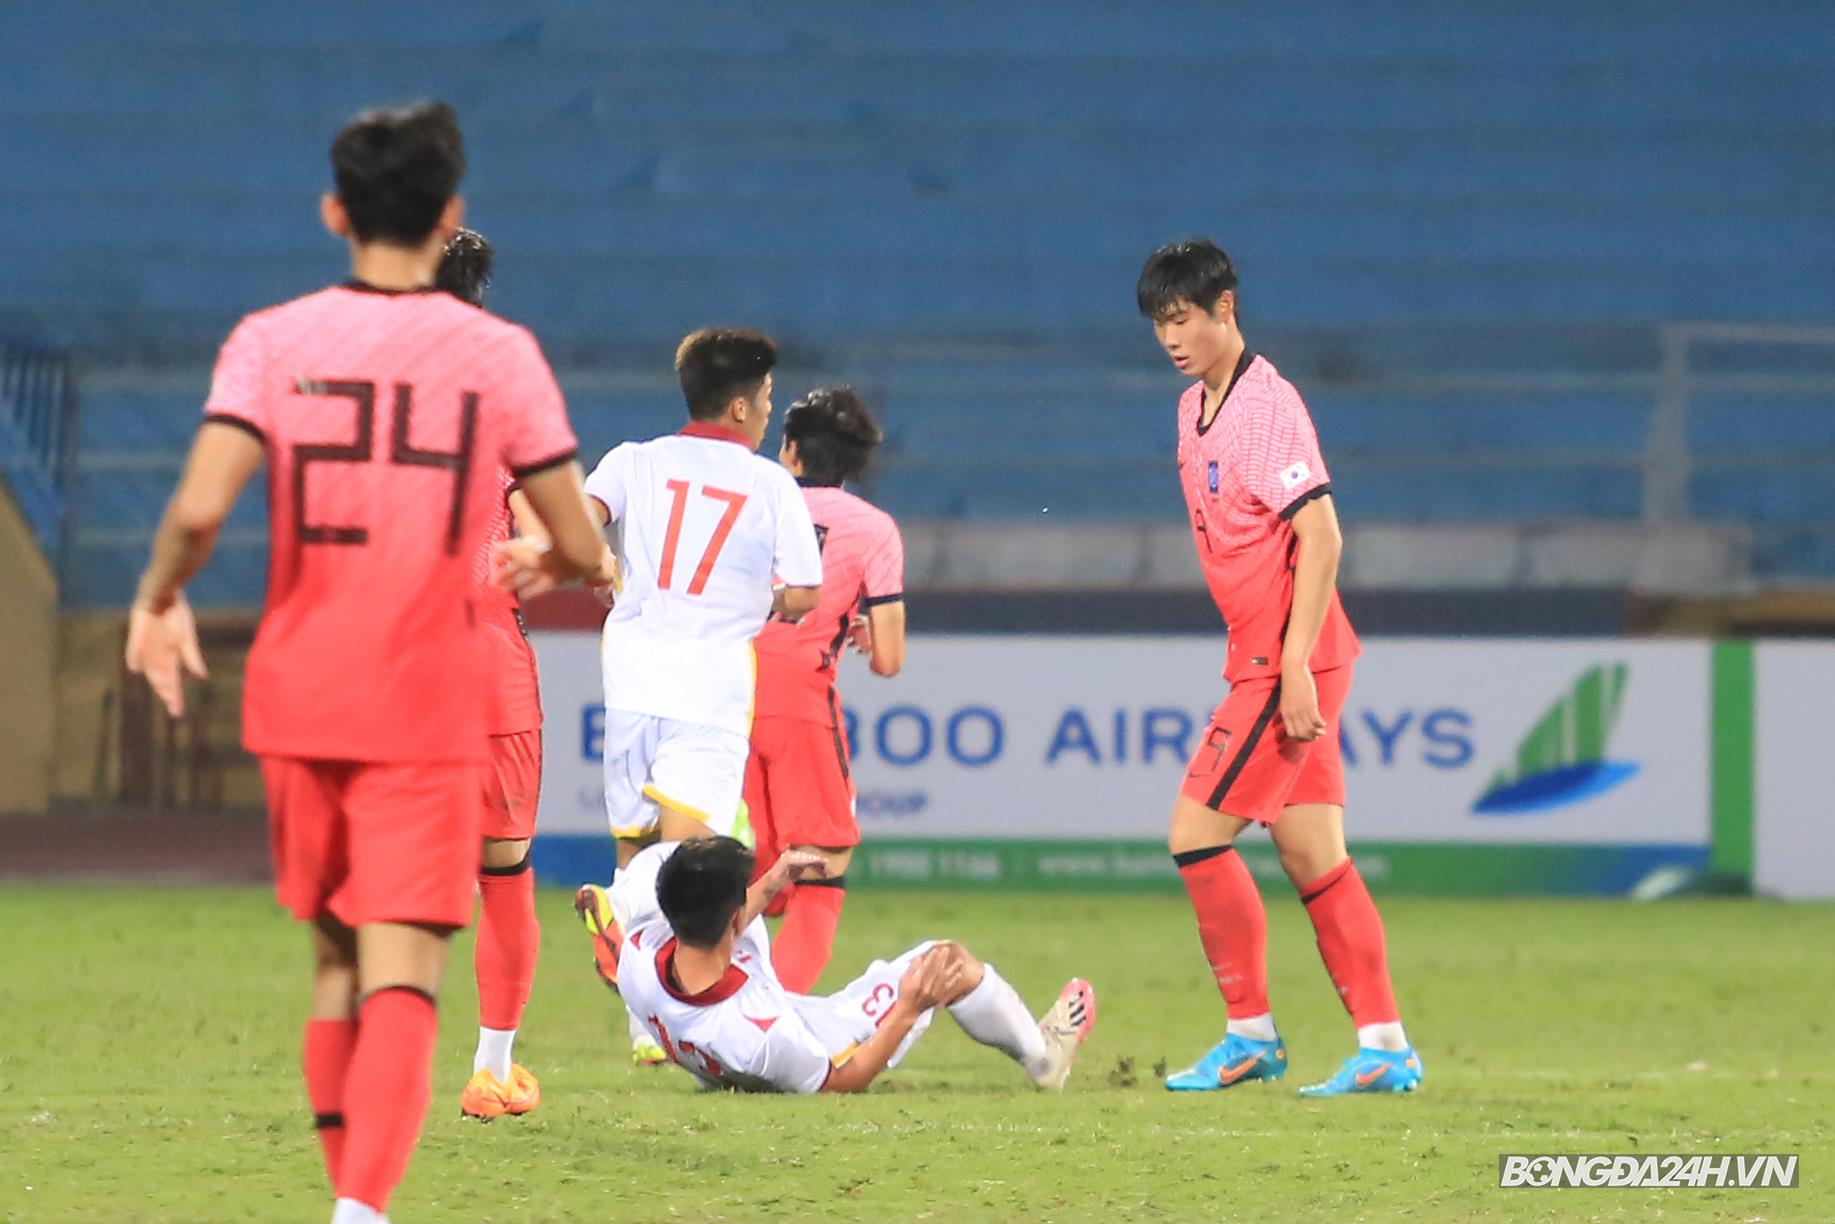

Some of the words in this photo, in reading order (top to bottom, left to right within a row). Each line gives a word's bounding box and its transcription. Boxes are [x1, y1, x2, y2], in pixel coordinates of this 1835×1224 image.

[291, 378, 480, 559] 24
[657, 478, 748, 596] 17
[1046, 705, 1475, 769] AIRYS
[1206, 726, 1232, 773] 9
